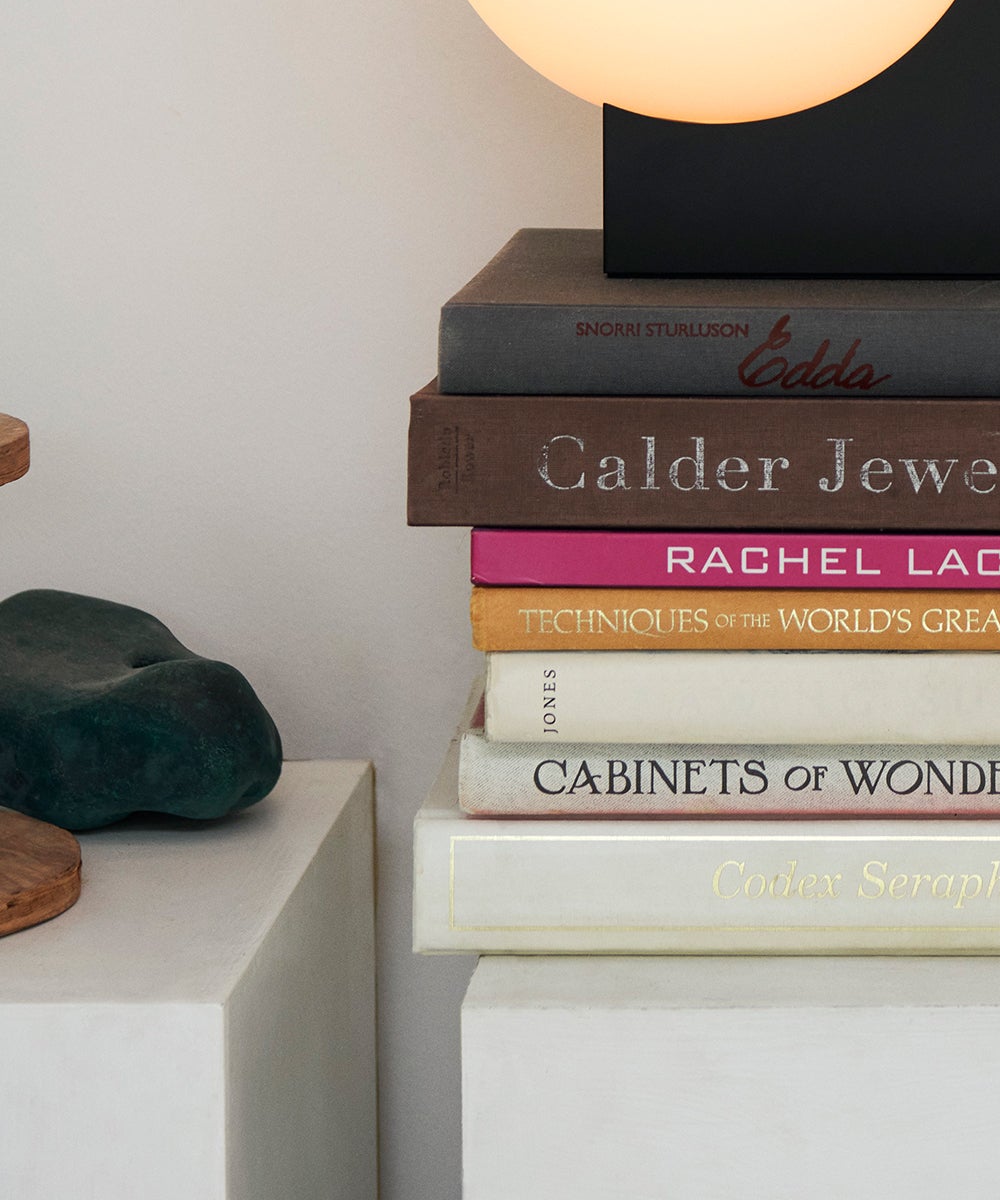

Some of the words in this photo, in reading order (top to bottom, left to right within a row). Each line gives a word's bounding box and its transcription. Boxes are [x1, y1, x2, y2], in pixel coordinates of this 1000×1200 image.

[576, 322, 640, 337] SNORRI
[646, 323, 749, 338] STURLUSON
[738, 314, 892, 390] Edda
[537, 435, 790, 491] Calder
[667, 546, 881, 575] RACHEL
[519, 608, 709, 638] TECHNIQUES
[715, 614, 736, 628] OF
[739, 614, 771, 628] THE
[778, 608, 911, 634] WORLD'S
[543, 669, 559, 734] JONES
[533, 759, 769, 796] CABINETS
[784, 765, 828, 792] OF
[711, 860, 842, 900] Codex
